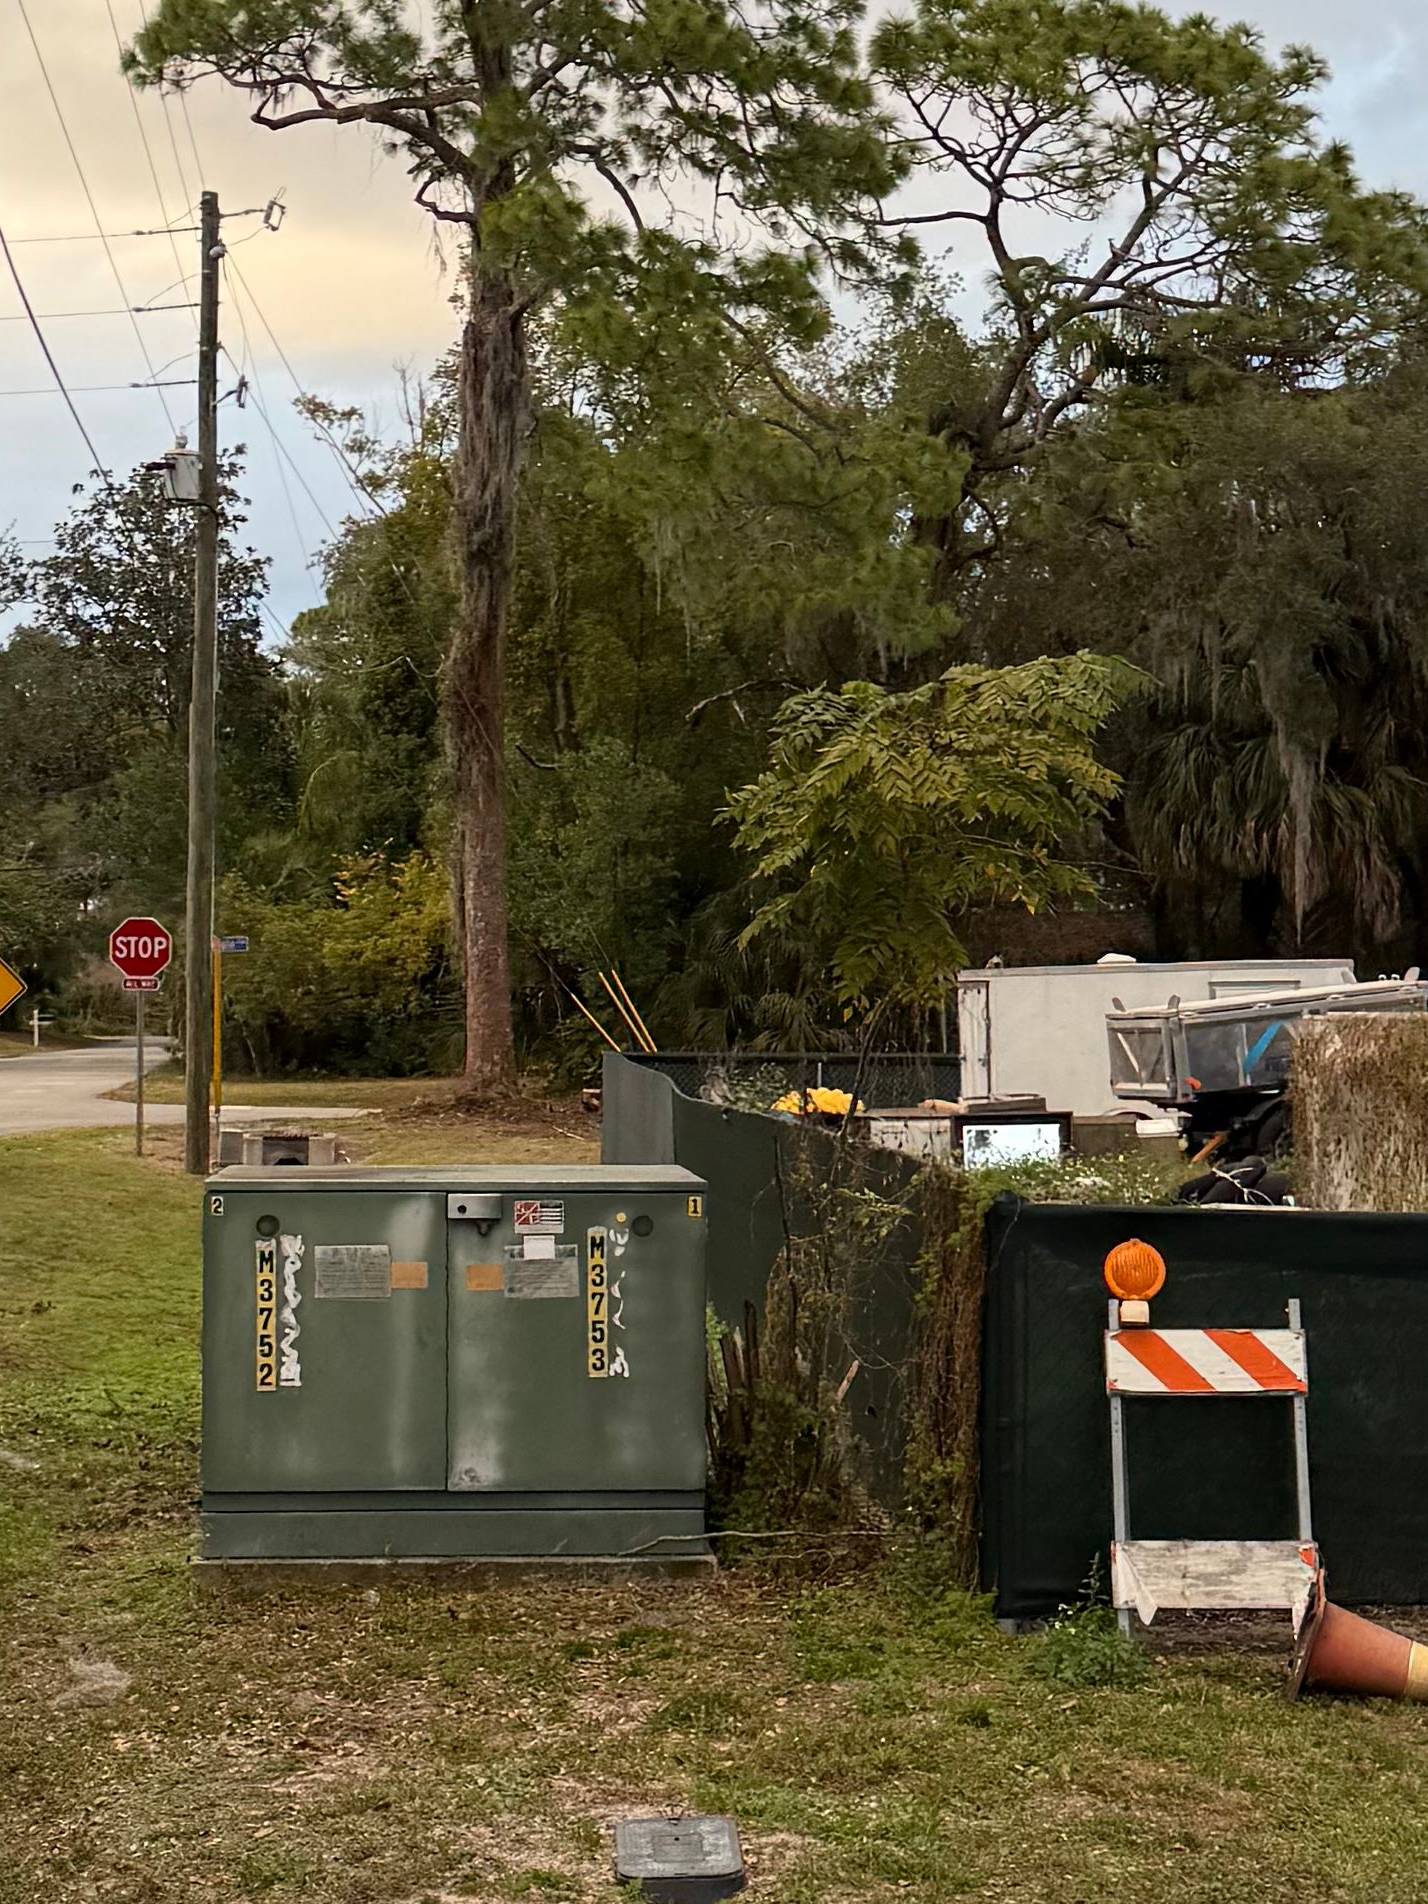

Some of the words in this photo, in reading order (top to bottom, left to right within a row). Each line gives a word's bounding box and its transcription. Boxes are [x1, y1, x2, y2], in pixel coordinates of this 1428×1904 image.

[115, 936, 167, 958] STOP
[212, 1197, 223, 1215] 2
[690, 1198, 700, 1215] 1
[590, 1235, 605, 1371] M3753
[259, 1250, 274, 1386] M3752
